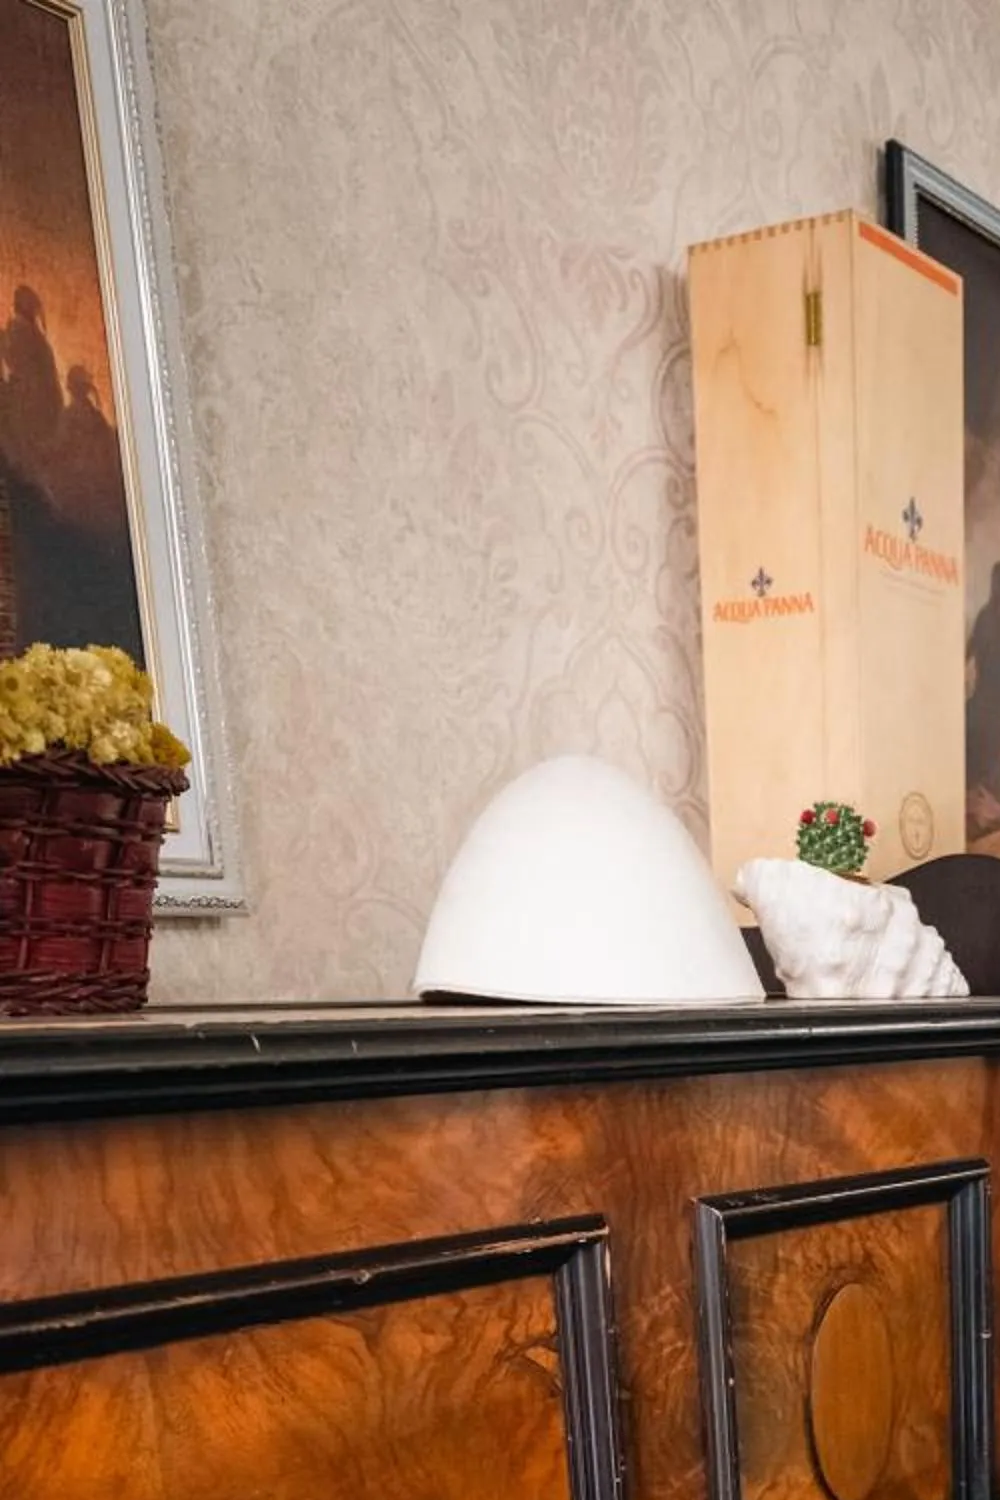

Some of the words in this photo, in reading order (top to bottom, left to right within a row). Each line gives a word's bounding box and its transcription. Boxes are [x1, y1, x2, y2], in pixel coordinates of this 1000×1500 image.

[864, 525, 911, 571] ACQUA
[914, 544, 959, 587] PANNA
[712, 599, 762, 624] ACQUA
[763, 591, 815, 617] PANNA
